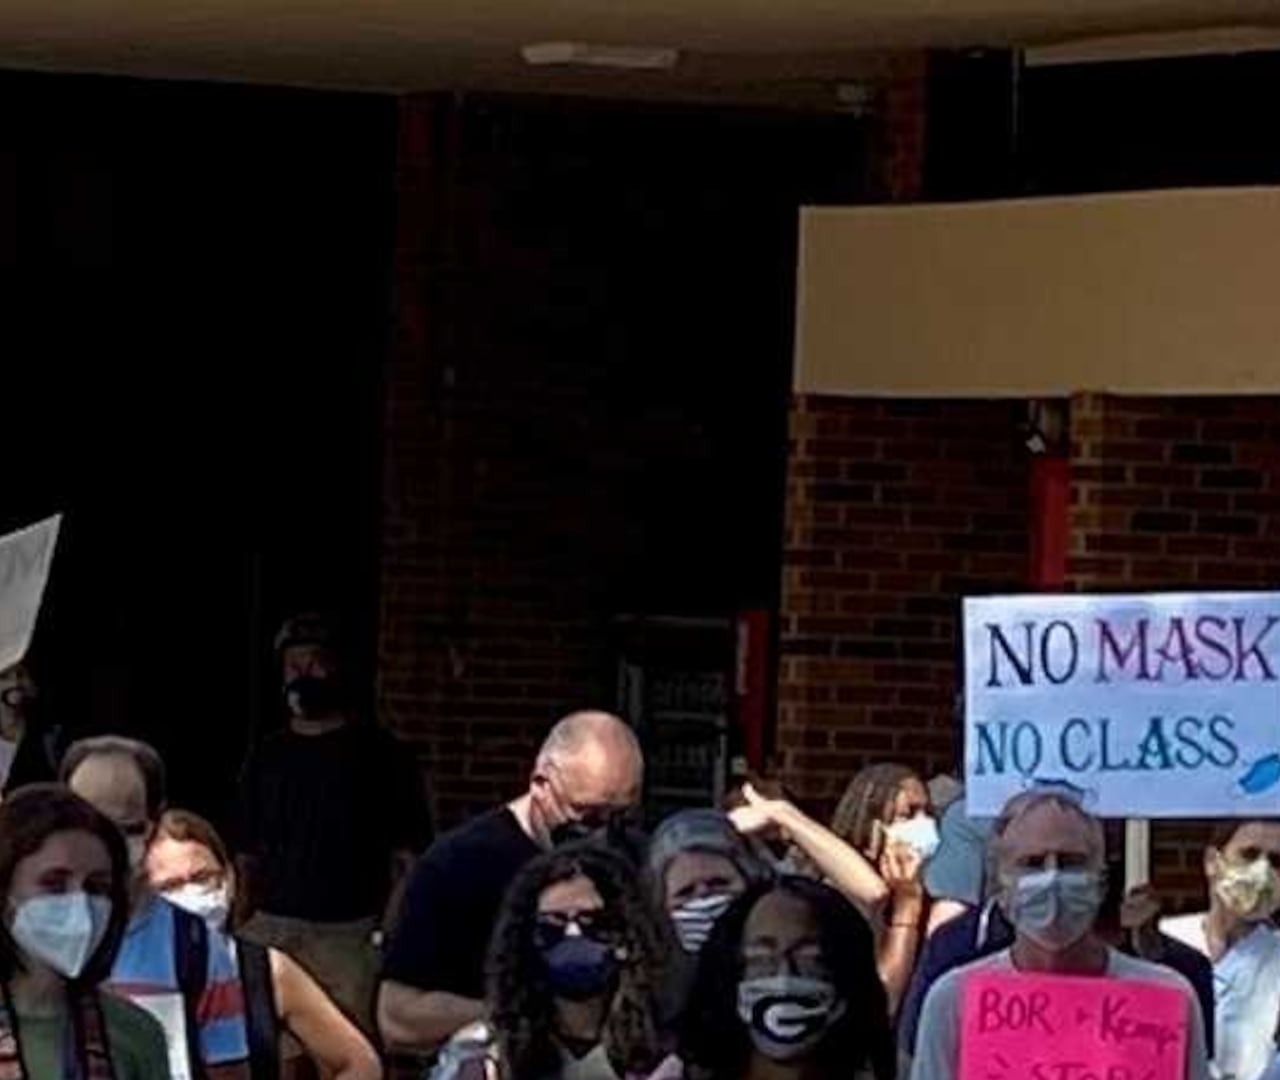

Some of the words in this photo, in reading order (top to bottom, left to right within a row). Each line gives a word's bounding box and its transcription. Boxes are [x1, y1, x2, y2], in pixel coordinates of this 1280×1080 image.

[984, 619, 1079, 687] NO
[973, 720, 1043, 777] NO
[1059, 714, 1240, 774] CLASS
[978, 988, 1056, 1036] BOR
